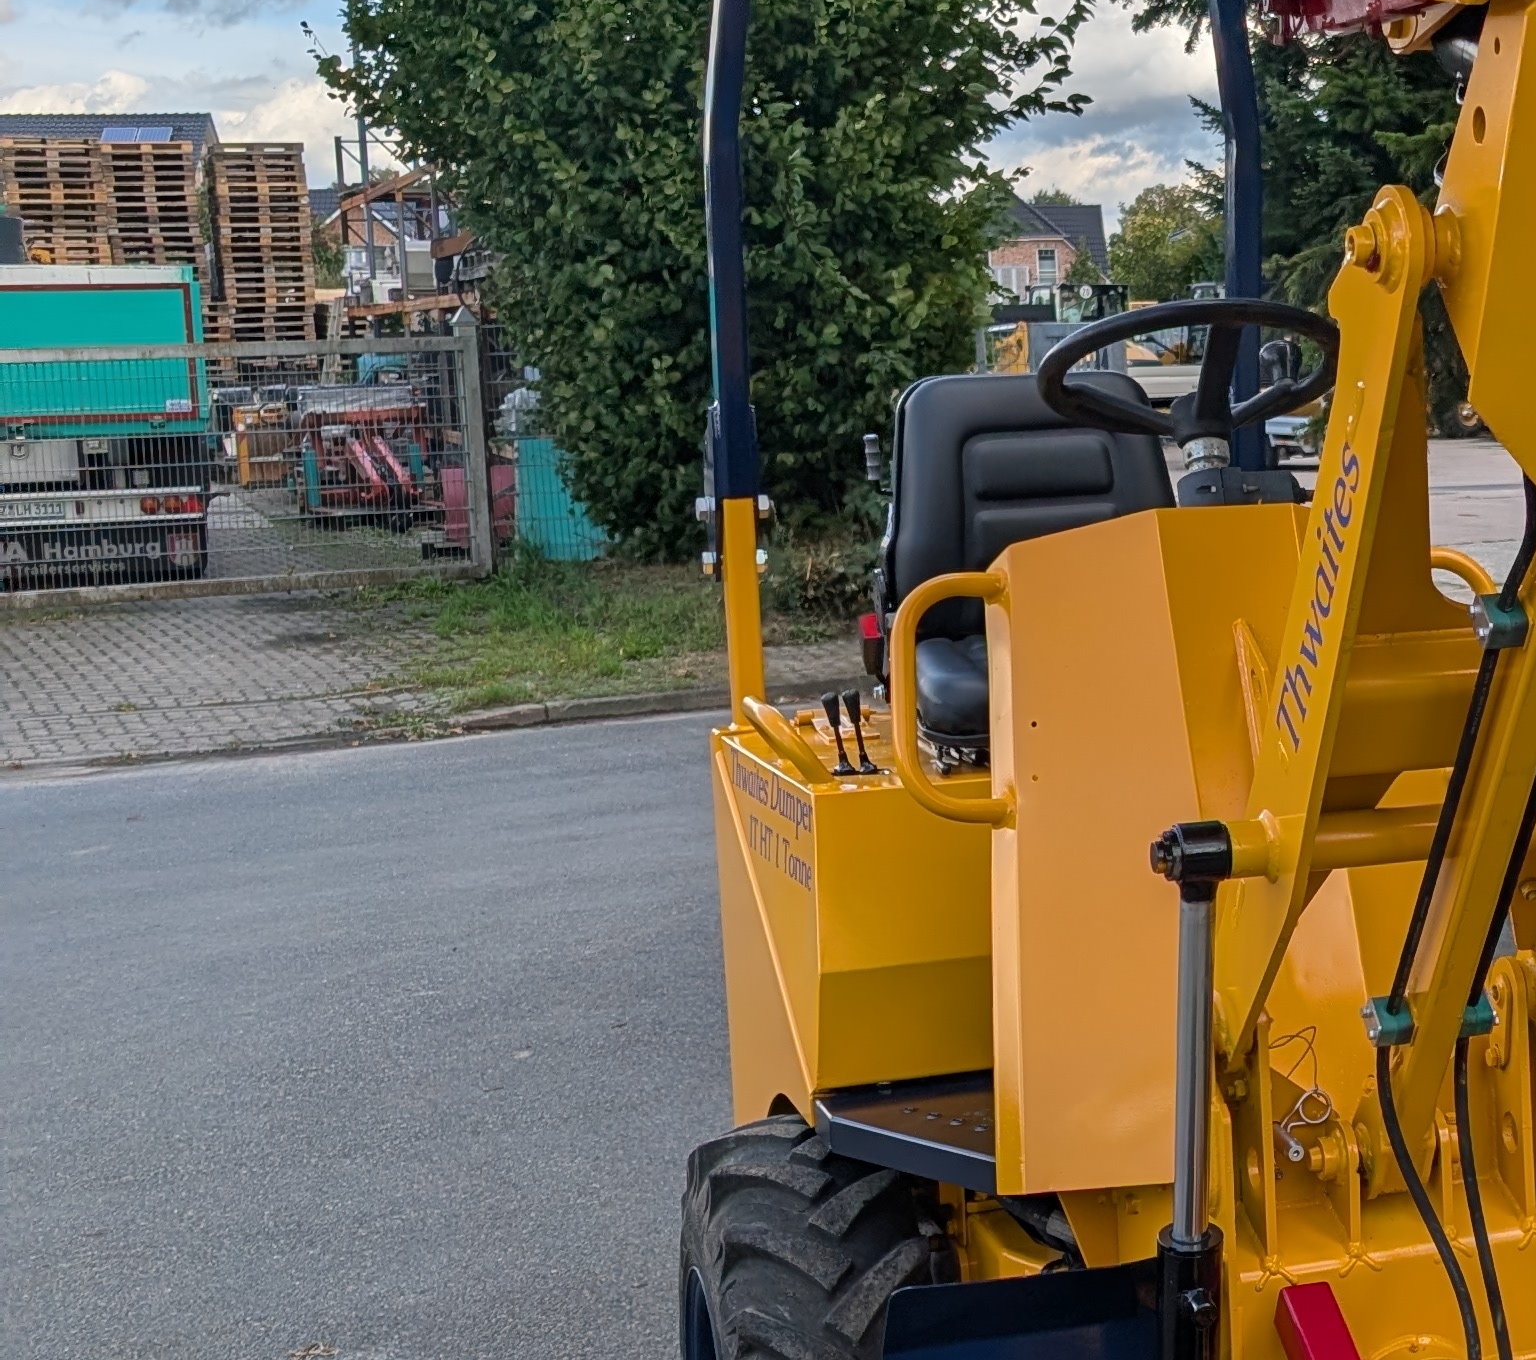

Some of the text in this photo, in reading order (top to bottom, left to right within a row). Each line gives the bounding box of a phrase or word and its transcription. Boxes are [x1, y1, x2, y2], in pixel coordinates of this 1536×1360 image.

[34, 503, 63, 515] 3111
[43, 539, 162, 560] Hamburg
[1276, 441, 1360, 754] Thwaites
[730, 747, 813, 840] Thwaites Dumper
[782, 837, 812, 892] Tonne
